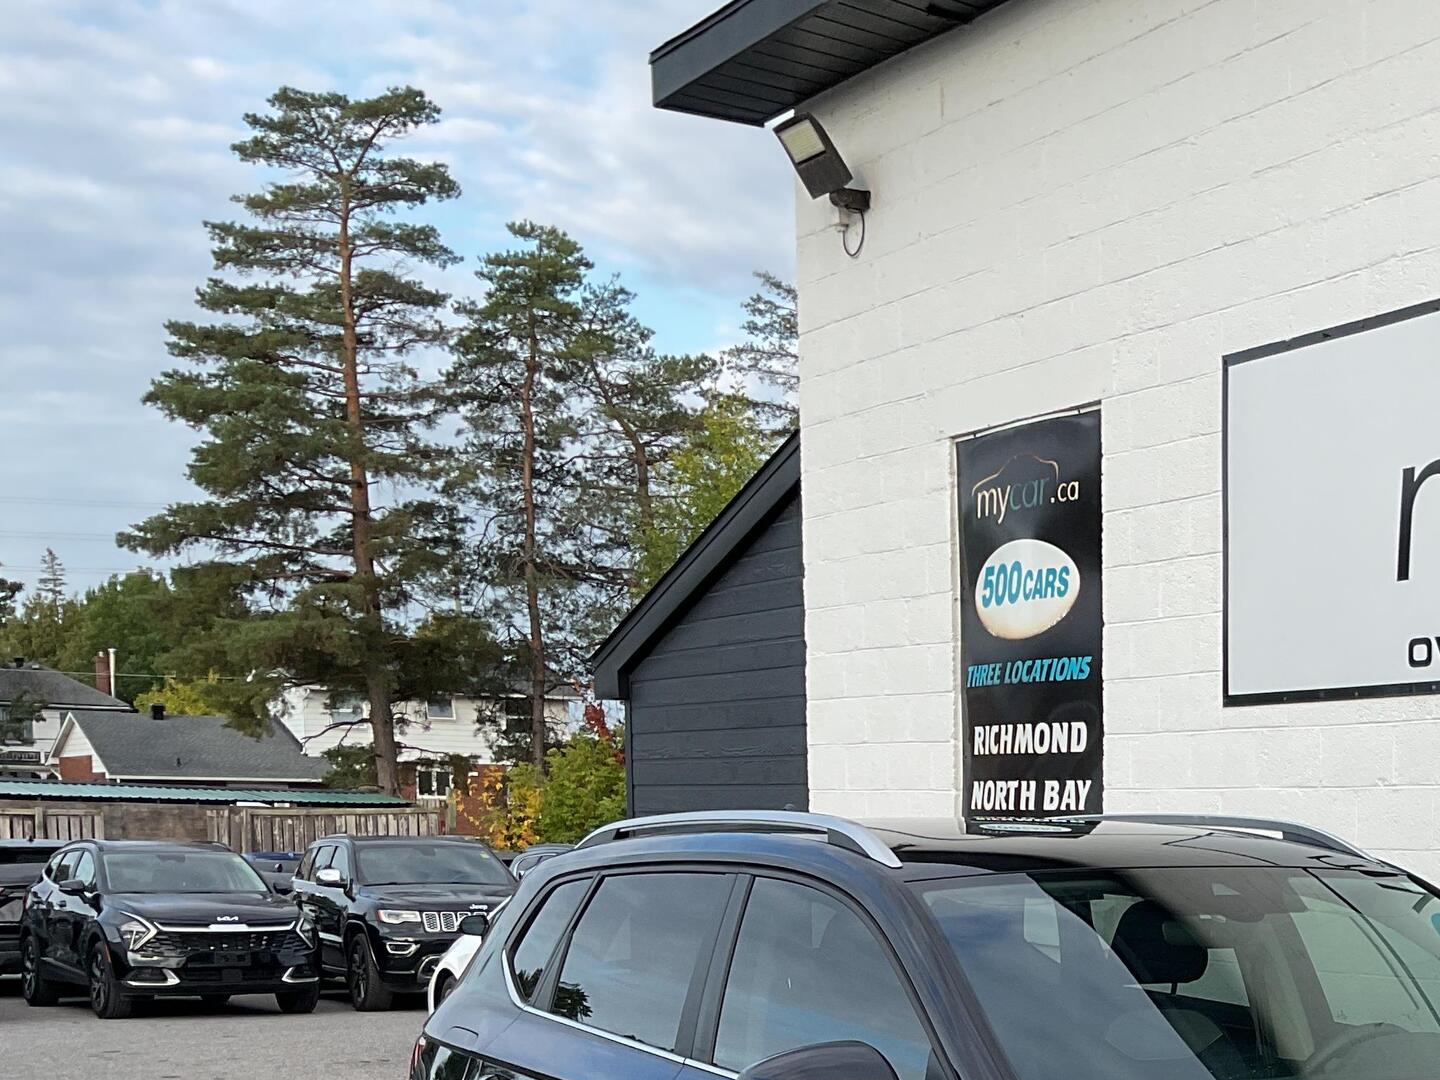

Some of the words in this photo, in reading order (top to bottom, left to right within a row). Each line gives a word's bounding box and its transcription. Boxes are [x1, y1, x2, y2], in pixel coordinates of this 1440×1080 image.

[981, 560, 1023, 609] 500
[1023, 567, 1069, 601] CARS
[967, 662, 1002, 689] THREE
[1004, 656, 1092, 683] LOCATIONS
[973, 721, 1088, 756] RICHMOND
[971, 778, 1035, 811] NORTH
[1042, 778, 1092, 811] BAY
